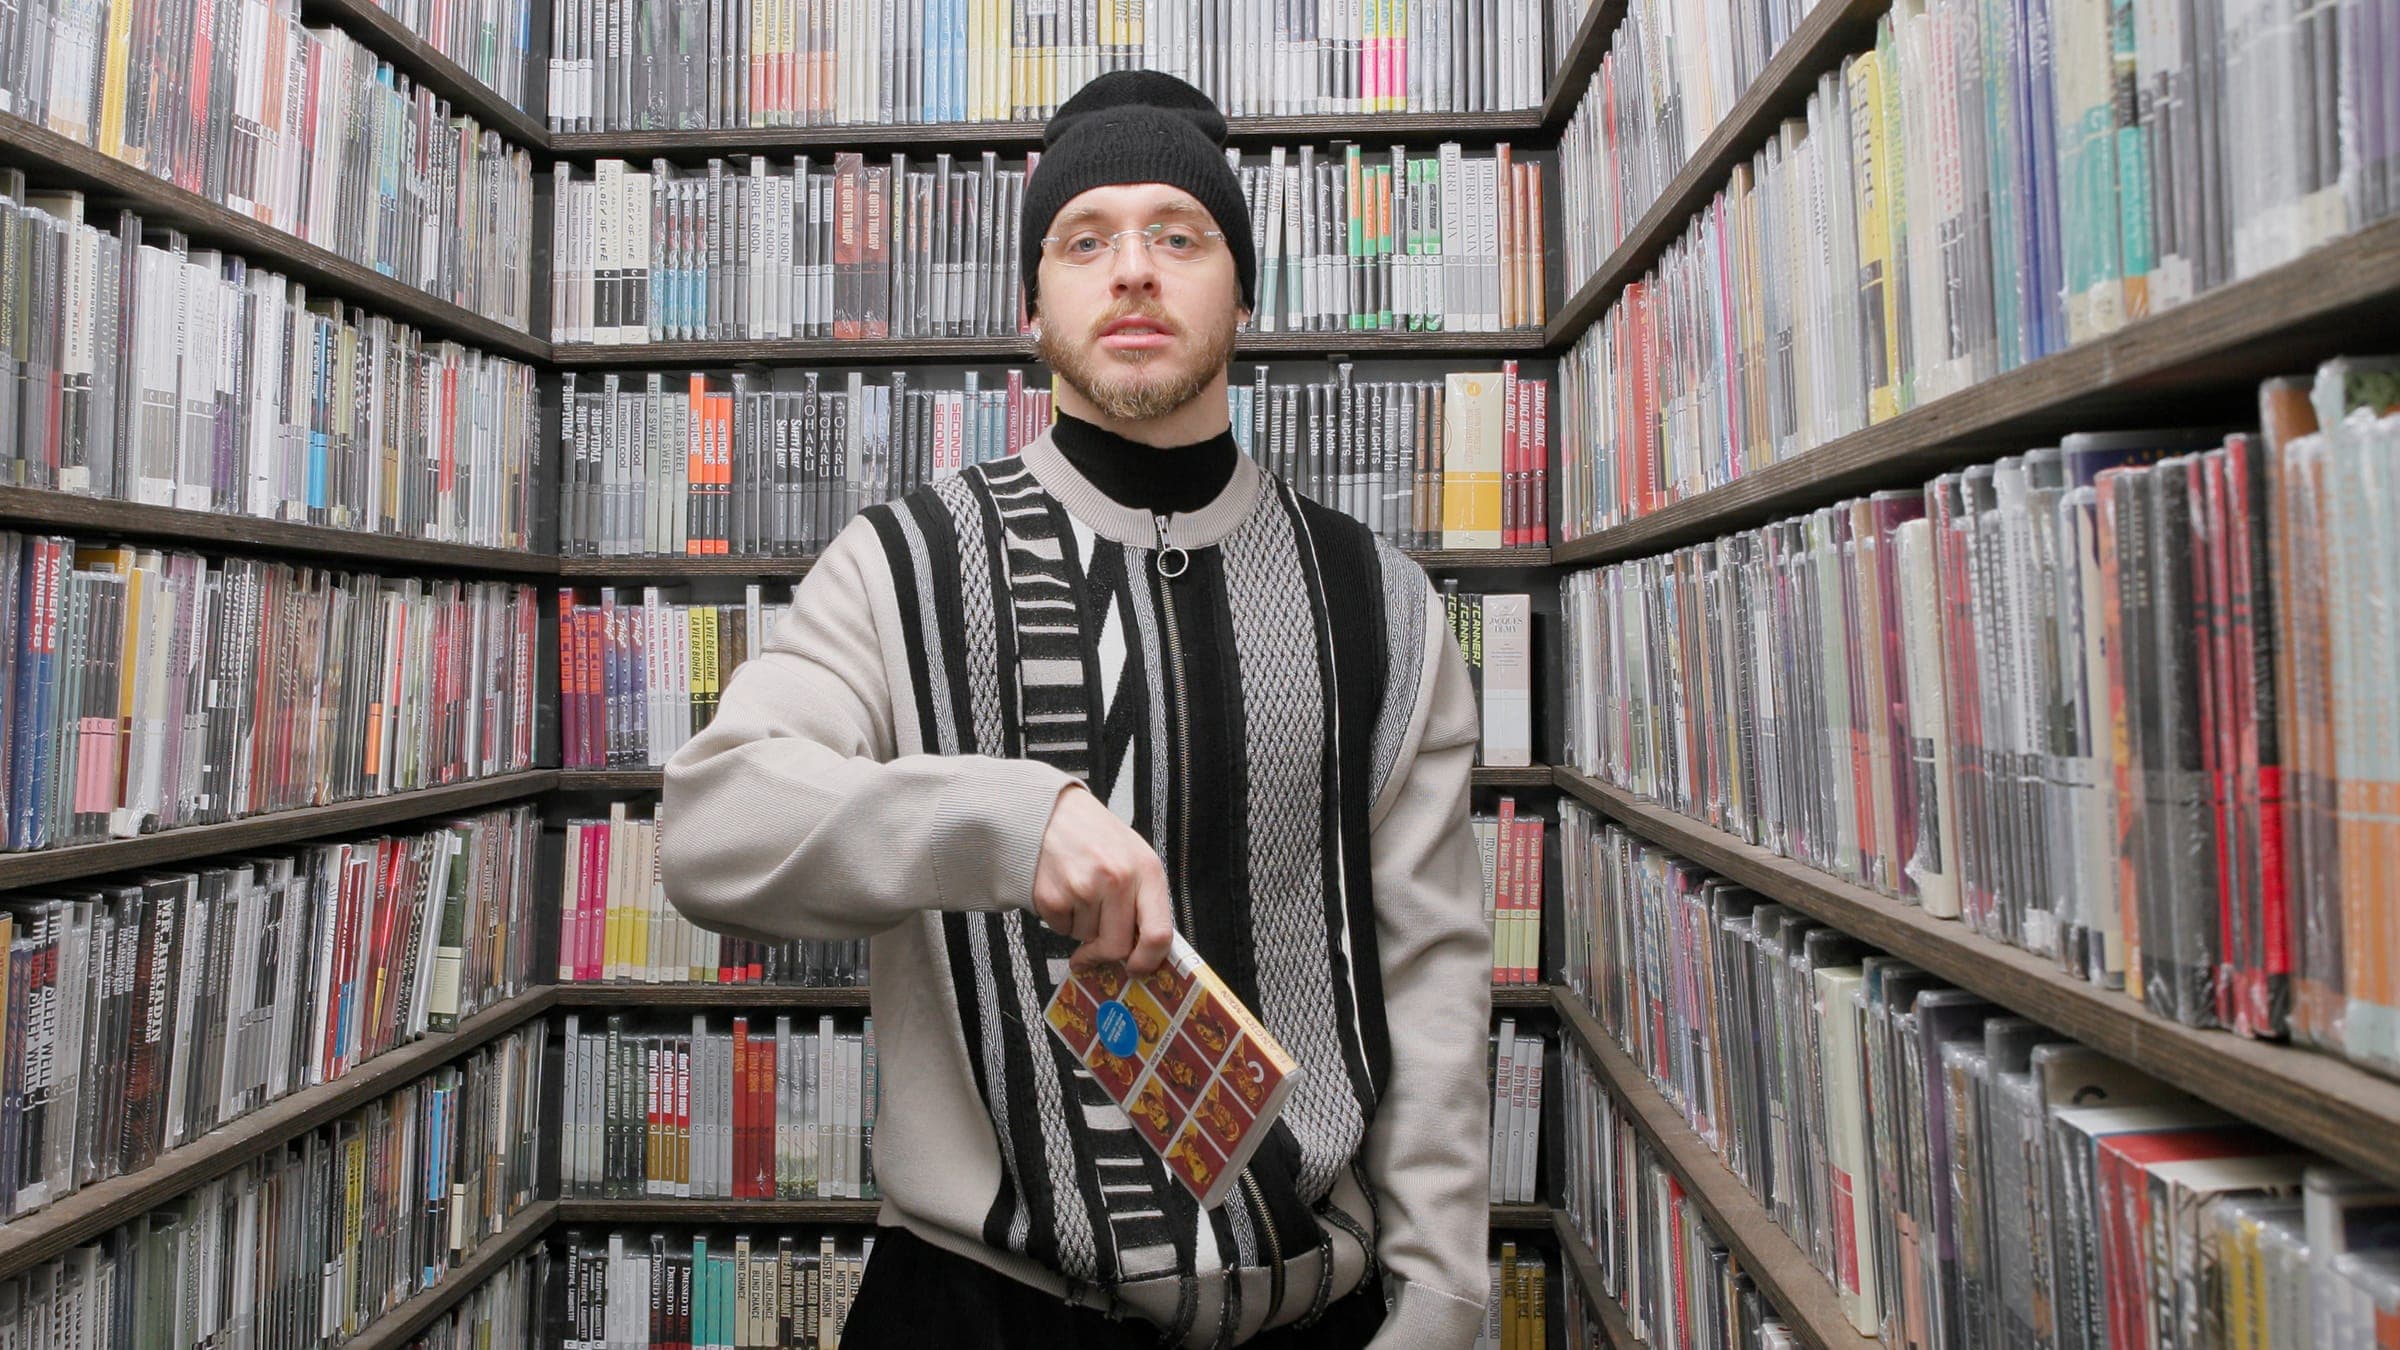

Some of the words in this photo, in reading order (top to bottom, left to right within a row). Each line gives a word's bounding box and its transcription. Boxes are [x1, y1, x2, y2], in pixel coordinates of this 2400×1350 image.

[869, 179, 879, 192] THE
[1483, 165, 1494, 209] PIERRE
[781, 185, 790, 228] PURPLE
[869, 194, 879, 216] QATSI
[781, 233, 790, 263] NOON
[869, 219, 879, 250] TRILOGY
[1483, 215, 1494, 253] ETAIX
[73, 240, 81, 307] HONEYMOON
[110, 264, 119, 349] UMBERTO
[0, 306, 8, 344] AMOUR
[71, 312, 79, 358] KILLERS
[108, 354, 118, 370] D.
[676, 404, 685, 425] LIFE
[1372, 396, 1381, 426] CITY
[1535, 386, 1546, 415] TOUKI
[633, 402, 642, 442] medium
[676, 428, 685, 436] IS
[790, 419, 802, 448] SAFETY
[951, 403, 960, 468] SECONDS
[1327, 415, 1336, 427] La
[1535, 418, 1546, 447] BOUKI
[633, 444, 642, 466] cool
[676, 441, 685, 473] SWEET
[1327, 429, 1336, 456] Notte
[1372, 427, 1381, 464] LIGHTS
[790, 448, 802, 468] LAST!
[49, 556, 60, 618] TANNER
[233, 574, 241, 619] YOUTH
[48, 622, 57, 648] '88
[632, 615, 642, 646] Thief
[706, 616, 716, 625] LA
[706, 627, 716, 639] VIE
[1472, 602, 1481, 668] SCANNERS
[1488, 617, 1523, 626] JACQUES
[228, 633, 237, 679] BEAST
[706, 640, 716, 648] DE
[706, 649, 716, 681] BOHÈME
[48, 915, 63, 945] THE
[160, 897, 173, 941] MR.
[46, 950, 59, 982] BAD
[151, 942, 170, 1042] ARKADIN
[44, 988, 57, 1038] SLEEP
[608, 1031, 617, 1053] EVERY
[40, 1042, 54, 1086] WELL
[608, 1054, 617, 1069] MAN
[678, 1053, 689, 1076] don't
[1532, 1066, 1542, 1079] Here
[608, 1072, 617, 1086] FOR
[678, 1077, 689, 1095] look
[1529, 1085, 1540, 1097] Your
[608, 1088, 617, 1120] HIMSELF
[678, 1097, 689, 1117] now
[1528, 1099, 1540, 1109] Life
[751, 1270, 759, 1291] BLIND
[822, 1252, 833, 1279] MISTER
[681, 1267, 690, 1303] DRESSED
[807, 1270, 818, 1304] BREAKER
[822, 1281, 833, 1318] JOHNSON
[681, 1305, 690, 1316] TO
[751, 1293, 759, 1320] CHANCE
[807, 1306, 818, 1337] MORANT
